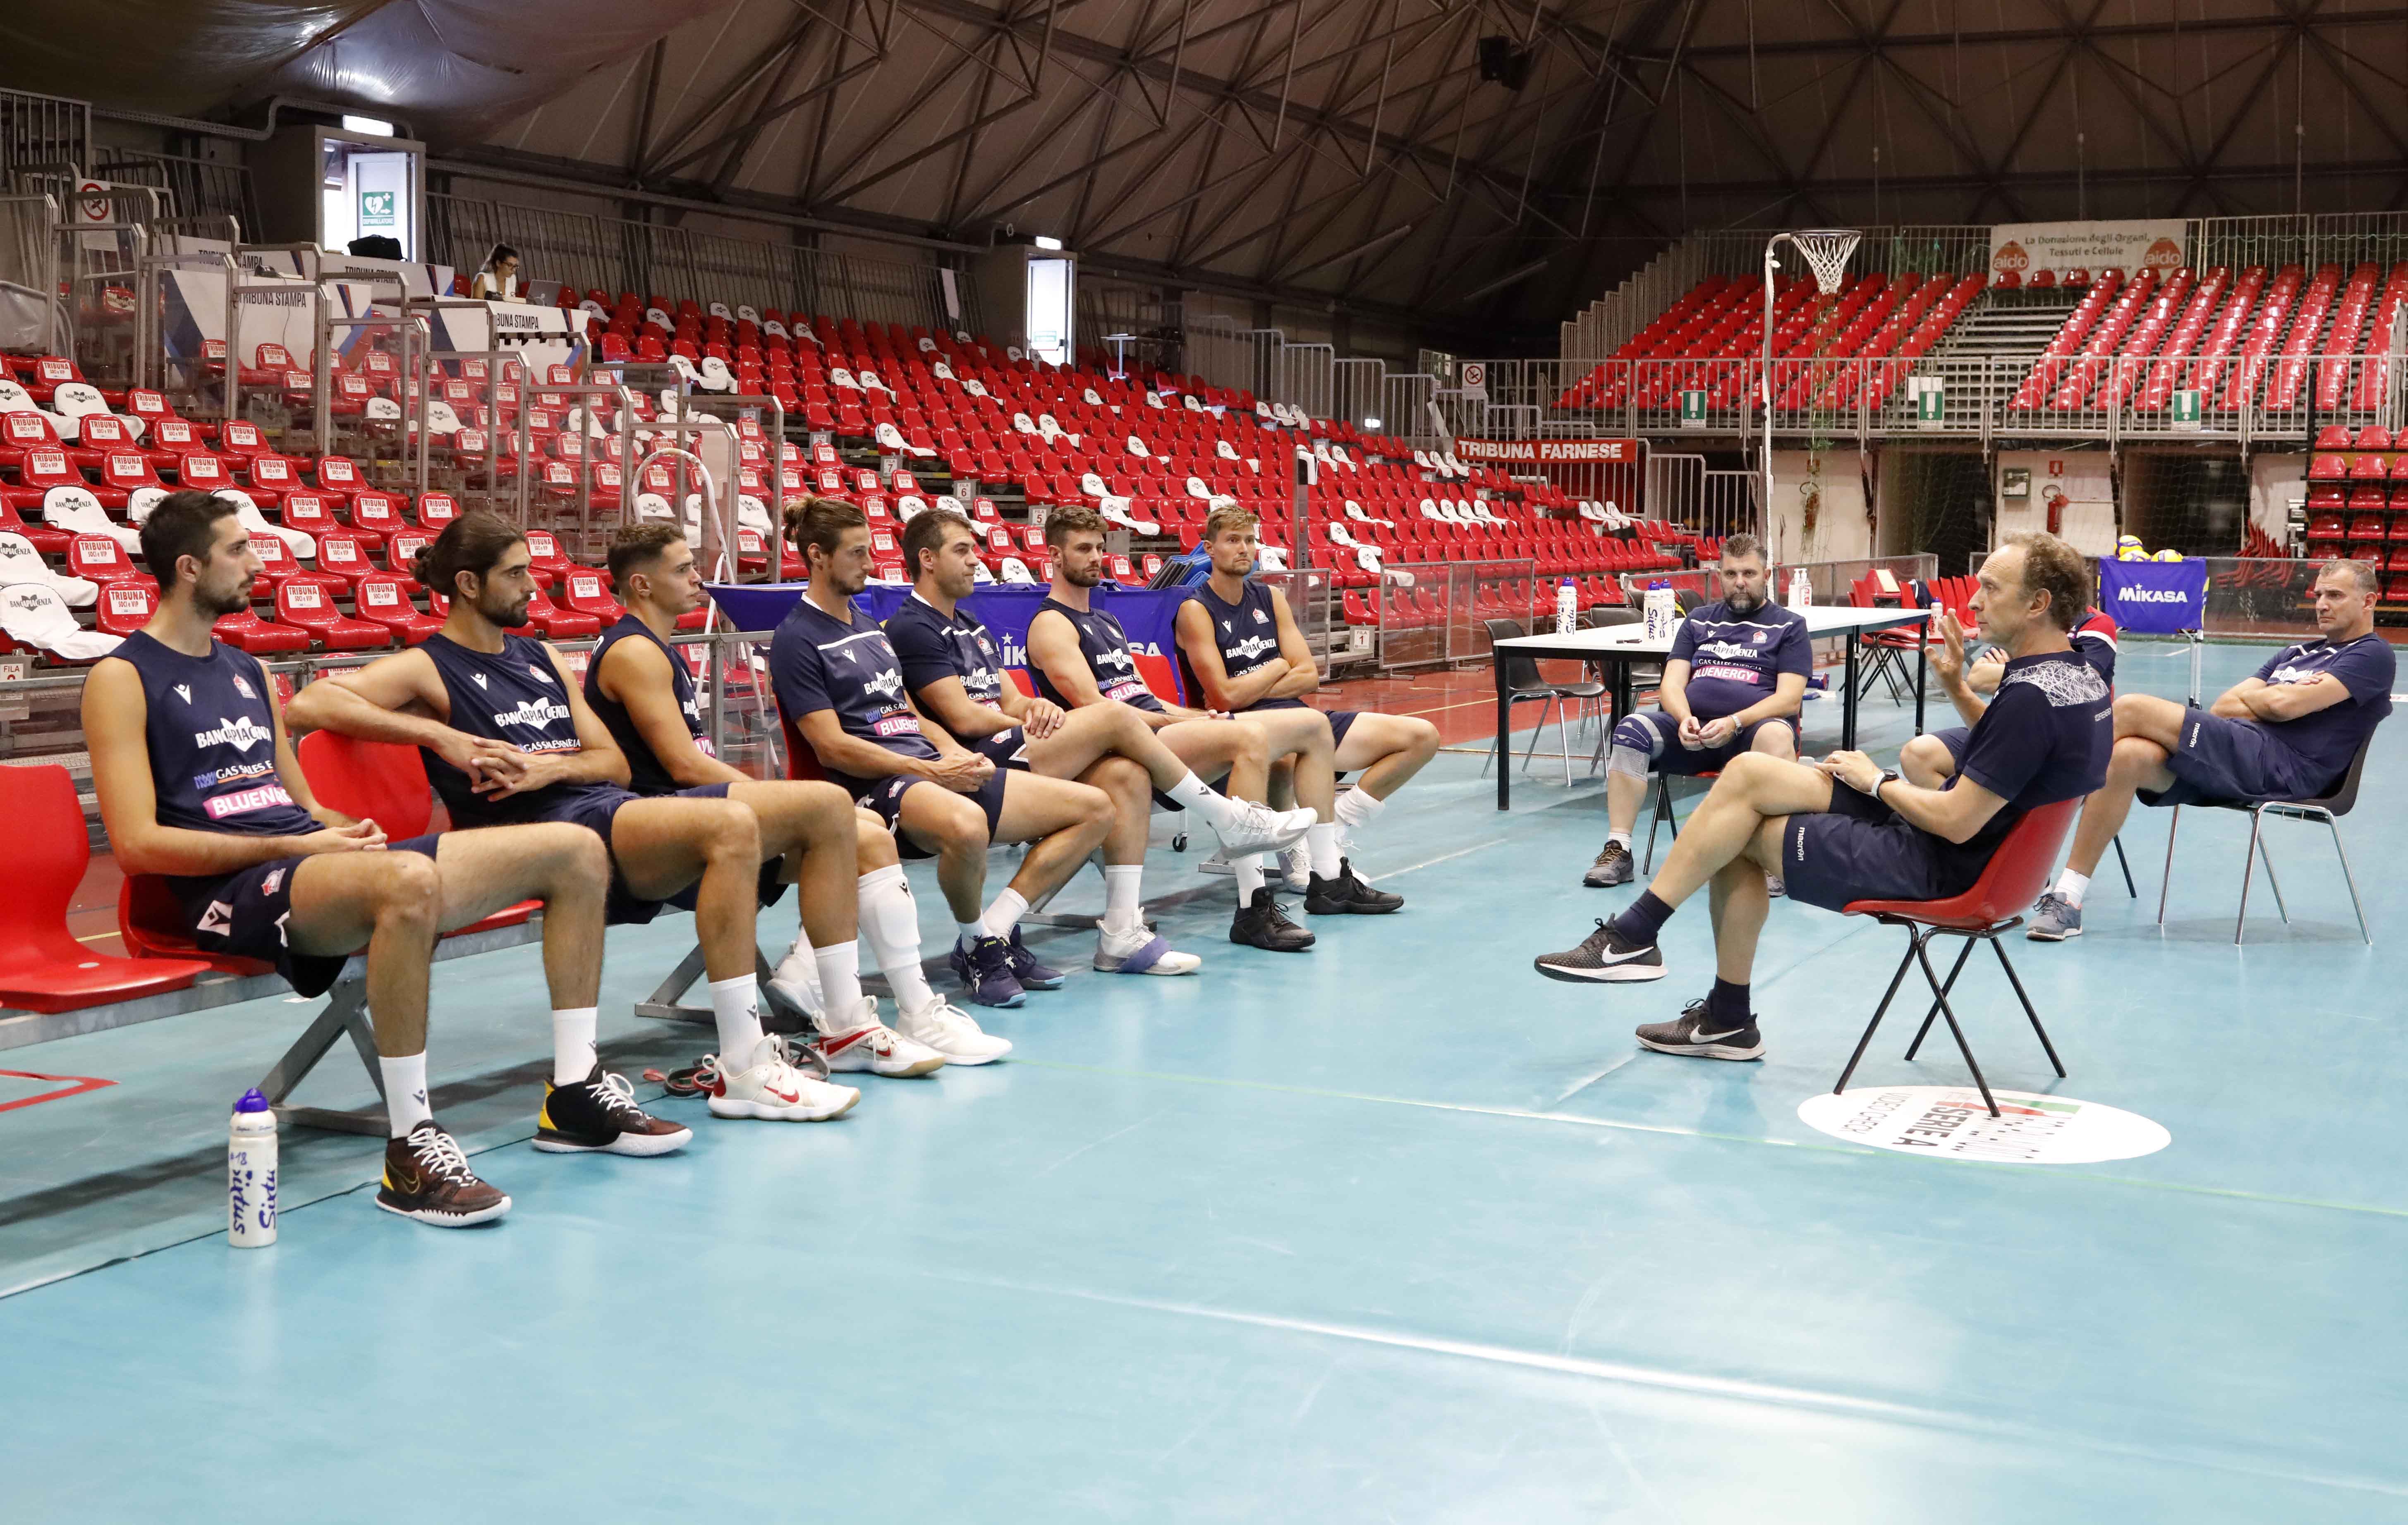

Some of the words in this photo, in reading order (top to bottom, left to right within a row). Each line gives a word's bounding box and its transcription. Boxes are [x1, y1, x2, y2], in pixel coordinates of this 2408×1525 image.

[2038, 236, 2086, 245] Donazione
[2090, 234, 2112, 244] degli
[2049, 247, 2082, 256] Tessuti
[2093, 247, 2124, 256] Cellule
[2145, 251, 2181, 265] aido
[1993, 254, 2028, 268] aido
[276, 292, 306, 308] STAMPA
[515, 315, 539, 330] STAMPA
[1458, 440, 1537, 459] TRIBUNA
[1541, 443, 1622, 459] FARNESE
[888, 464, 893, 472] 7
[961, 488, 967, 497] 6
[1036, 514, 1042, 523] 5
[81, 542, 113, 550] TRIBUNA
[250, 540, 279, 549] TRIBUNA
[111, 591, 144, 600] TRIBUNA
[288, 586, 318, 595] TRIBUNA
[367, 584, 395, 593] TRIBUNA
[10, 597, 52, 609] BANCAPIACENZA
[1647, 607, 1658, 641] Sixtus
[1359, 635, 1363, 645] 1
[1226, 638, 1276, 659] BANCAPIACENZA
[1698, 643, 1758, 658] BANCAPIACENZA
[1693, 667, 1755, 681] BLUENERGY
[494, 705, 570, 727] BANCAPIACENZA
[880, 705, 893, 714] GAS
[2189, 722, 2201, 748] macron
[216, 765, 239, 779] GAS
[1797, 827, 1805, 861] macron
[1867, 1092, 1913, 1111] VIDEO
[1904, 1107, 1974, 1138] SERIE
[1891, 1136, 1939, 1147] A
